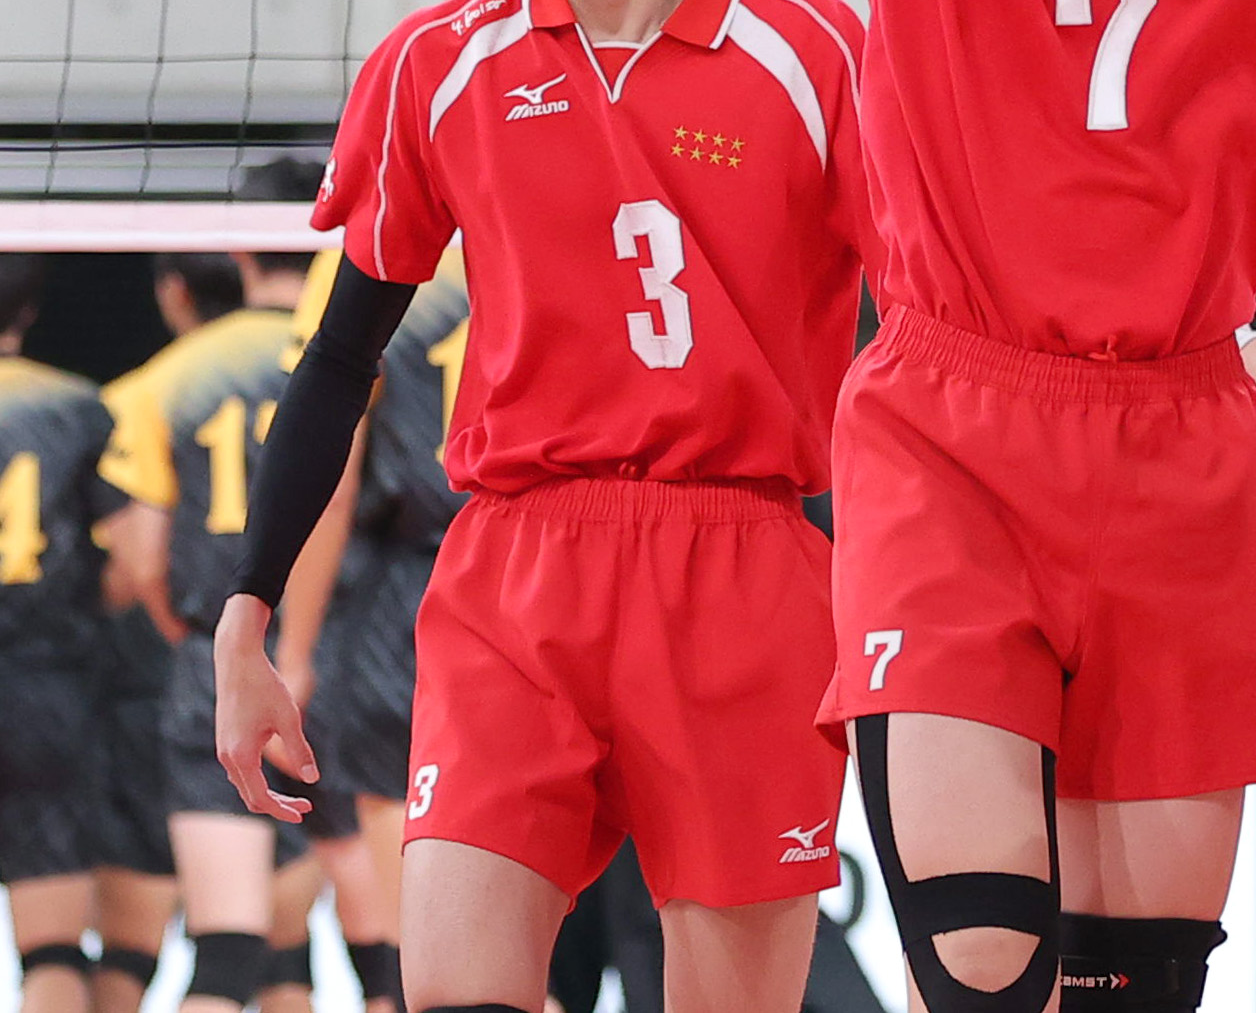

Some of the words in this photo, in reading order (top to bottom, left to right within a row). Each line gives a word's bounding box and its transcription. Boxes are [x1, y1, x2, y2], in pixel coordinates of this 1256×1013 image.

[505, 100, 569, 121] MIZUNO
[612, 199, 694, 369] 3
[195, 396, 278, 535] 1
[864, 629, 903, 691] 7
[408, 764, 439, 820] 3
[779, 846, 830, 863] MIZUNO
